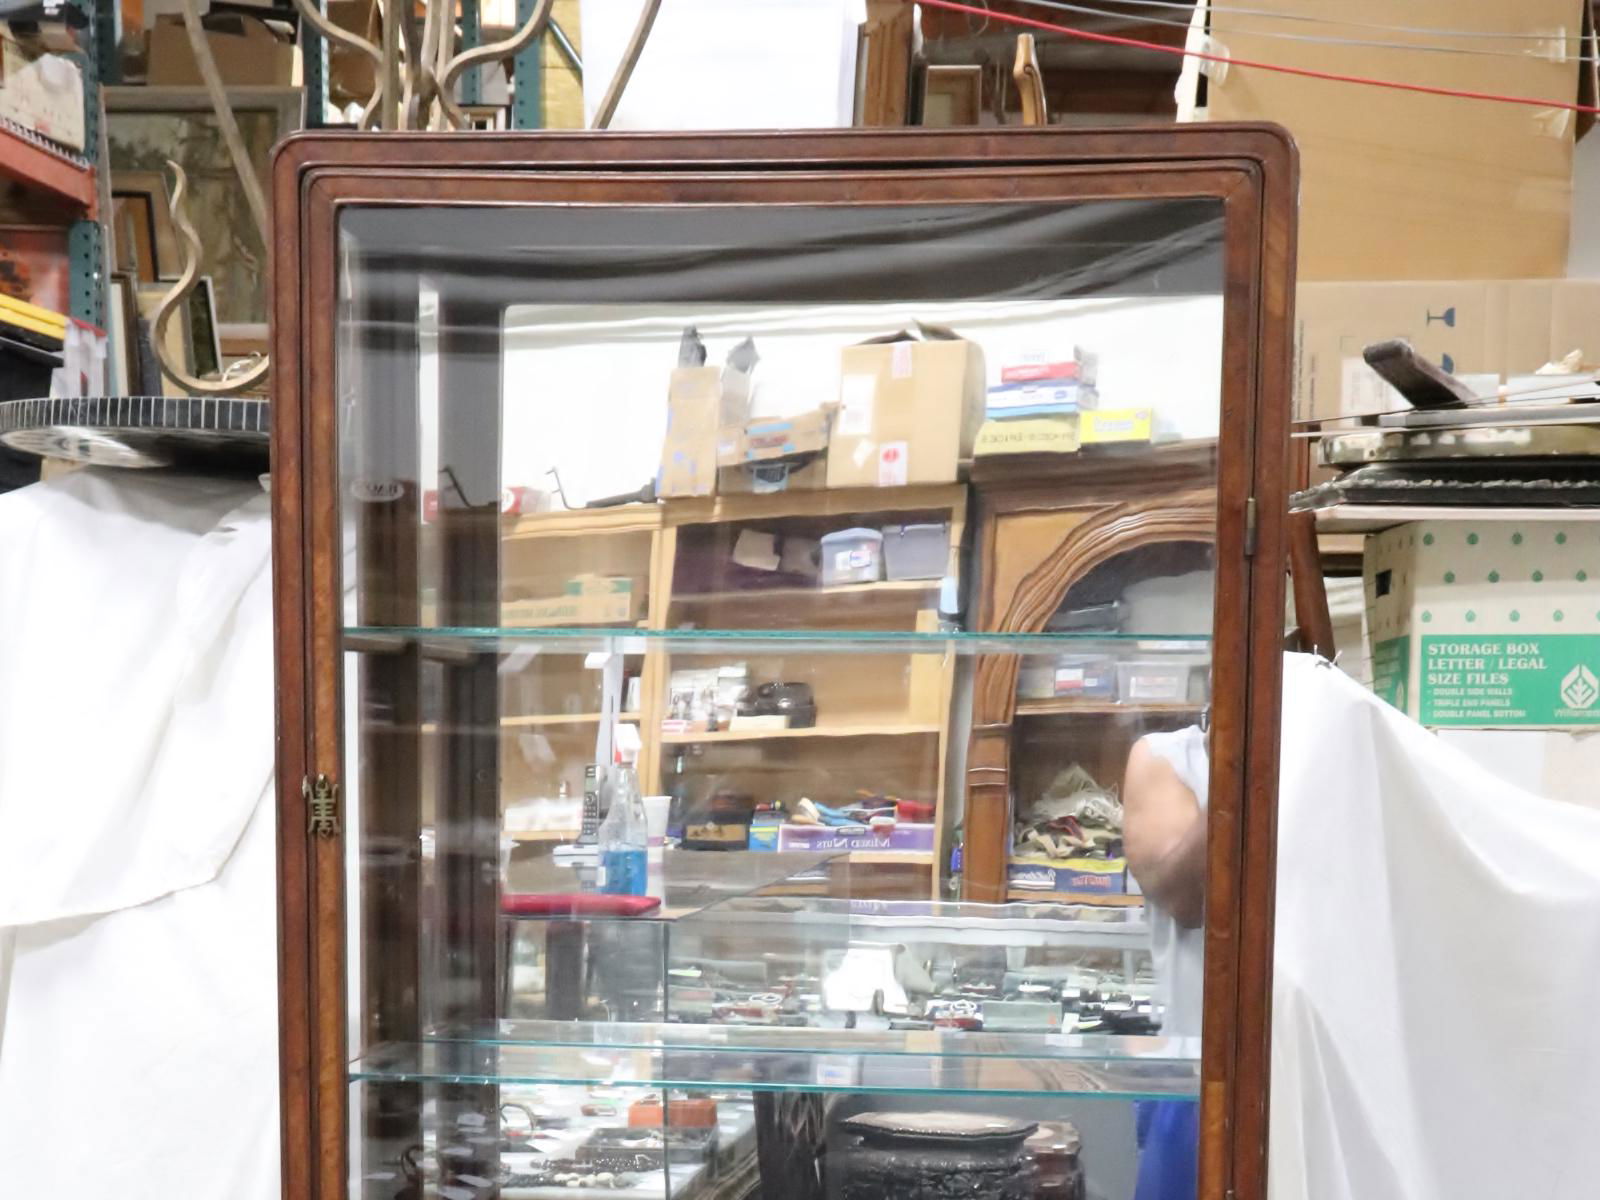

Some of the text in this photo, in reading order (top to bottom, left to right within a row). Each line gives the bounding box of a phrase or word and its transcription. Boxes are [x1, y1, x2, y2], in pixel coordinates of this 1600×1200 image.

[1428, 643, 1540, 656] STORAGE BOX
[1428, 658, 1485, 670] LETTER
[1498, 658, 1548, 670] LEGAL
[1428, 672, 1509, 685] SIZE FILES
